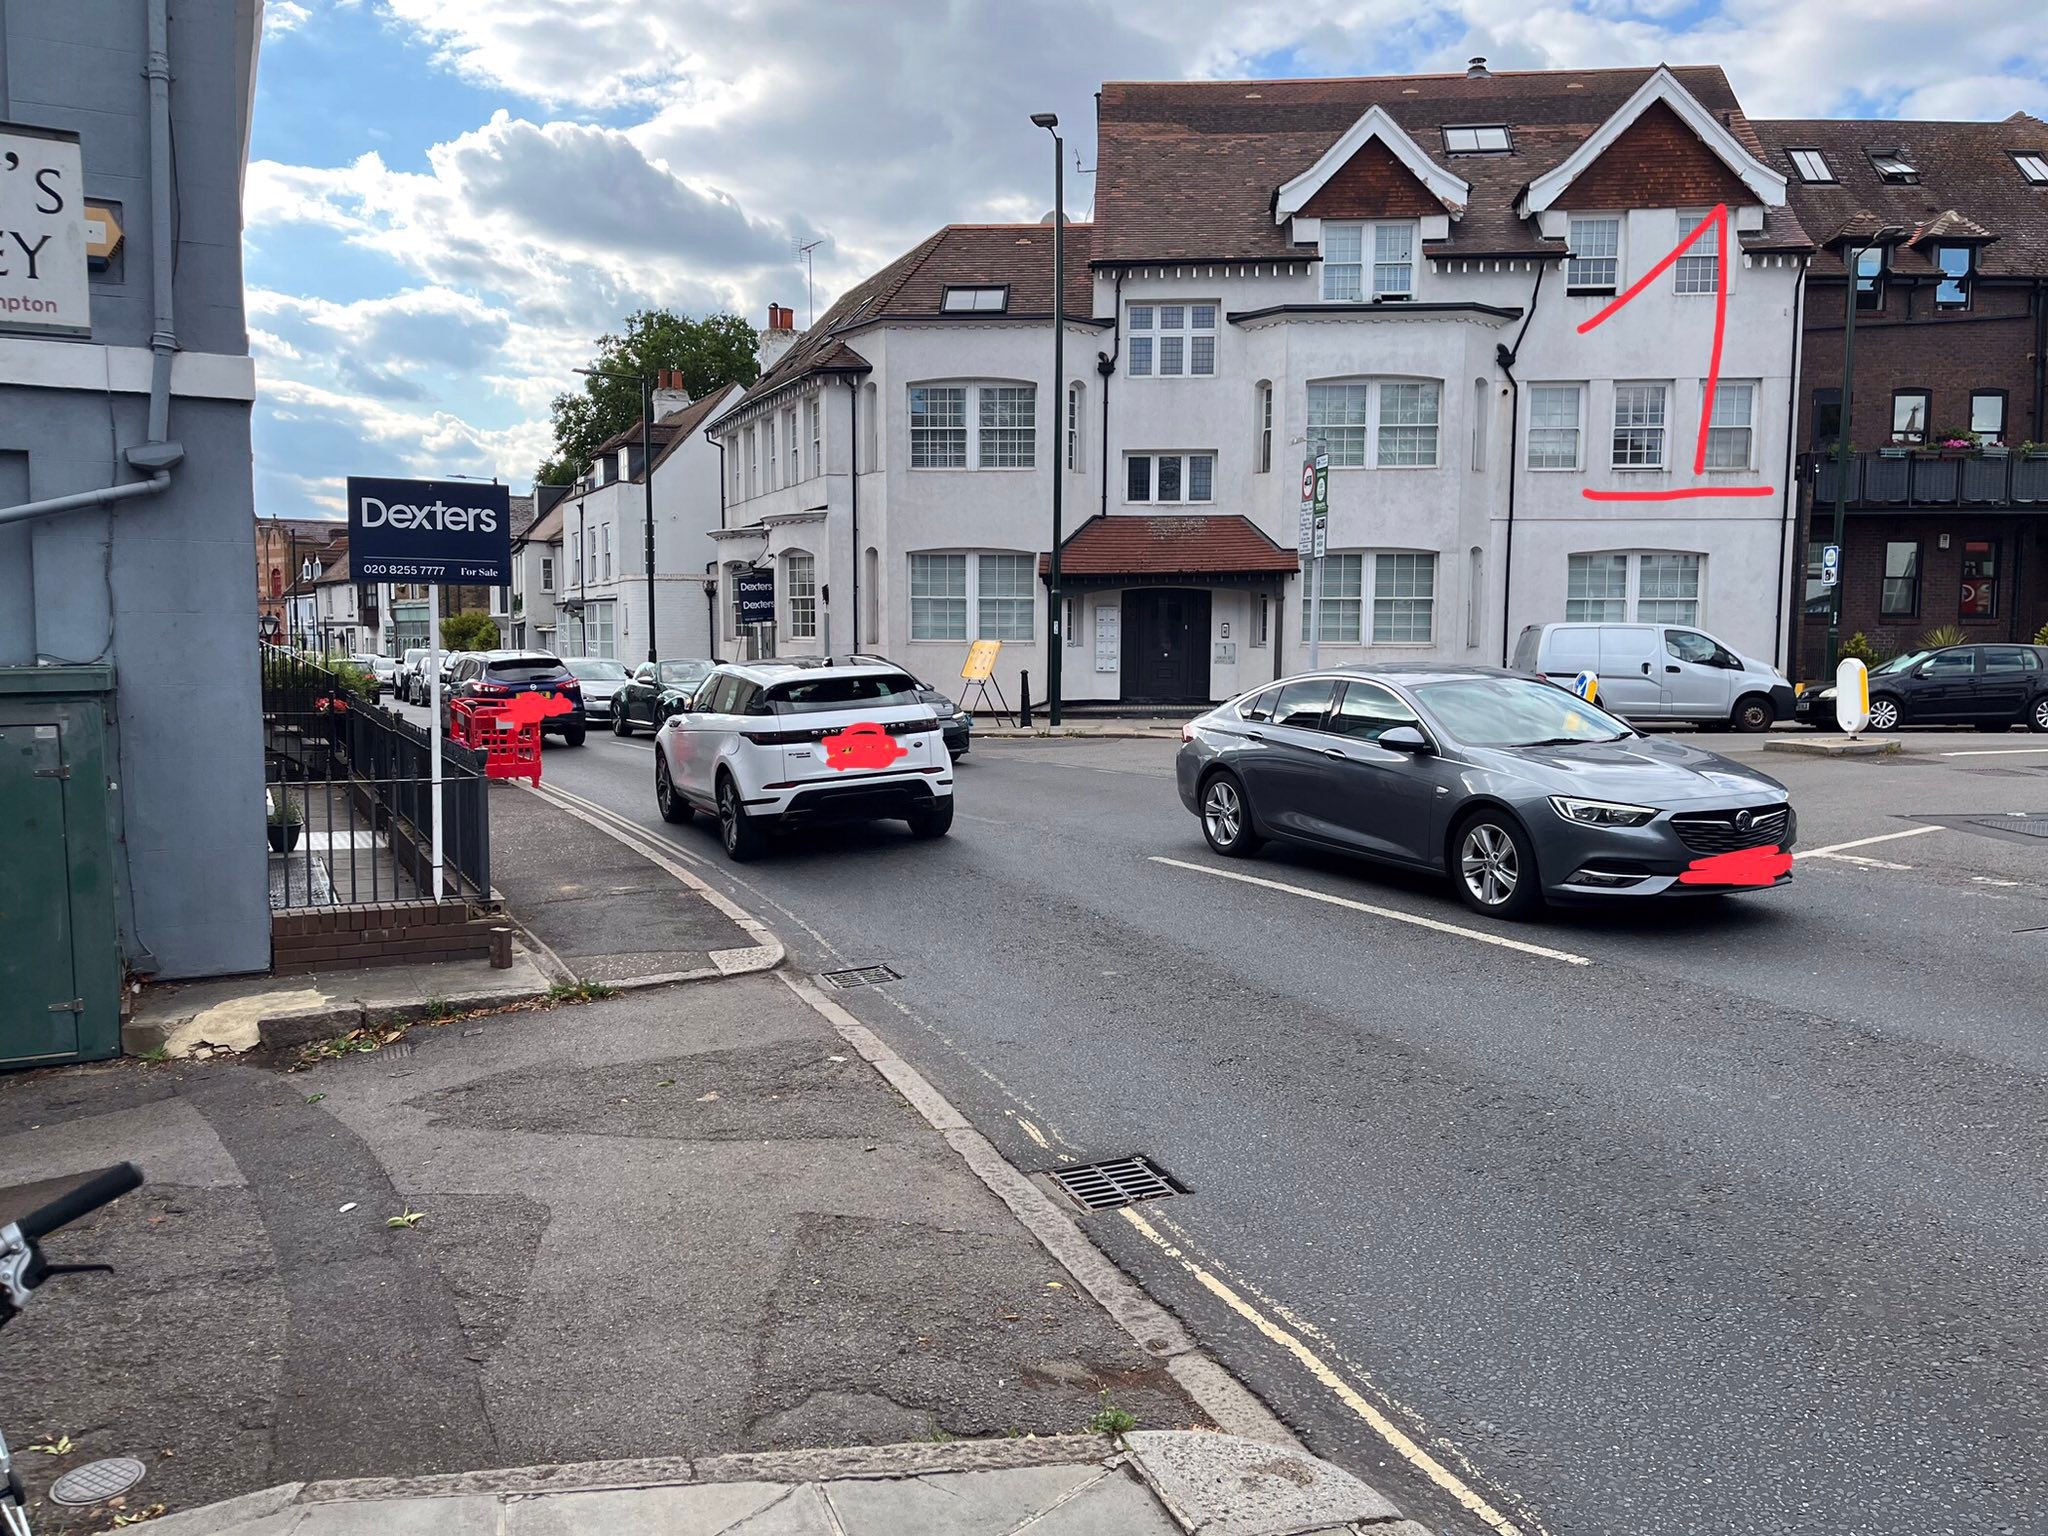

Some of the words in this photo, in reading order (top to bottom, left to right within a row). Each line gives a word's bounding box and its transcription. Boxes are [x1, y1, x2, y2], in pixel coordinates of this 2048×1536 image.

[0, 151, 64, 214] 'S
[0, 230, 52, 279] Y
[361, 497, 498, 533] Dexters
[363, 564, 387, 574] 020
[389, 565, 418, 575] 8255
[420, 566, 446, 576] 7777
[461, 567, 476, 576] For
[478, 568, 499, 577] Sale
[740, 582, 773, 591] Dexters
[742, 600, 775, 609] Dexters
